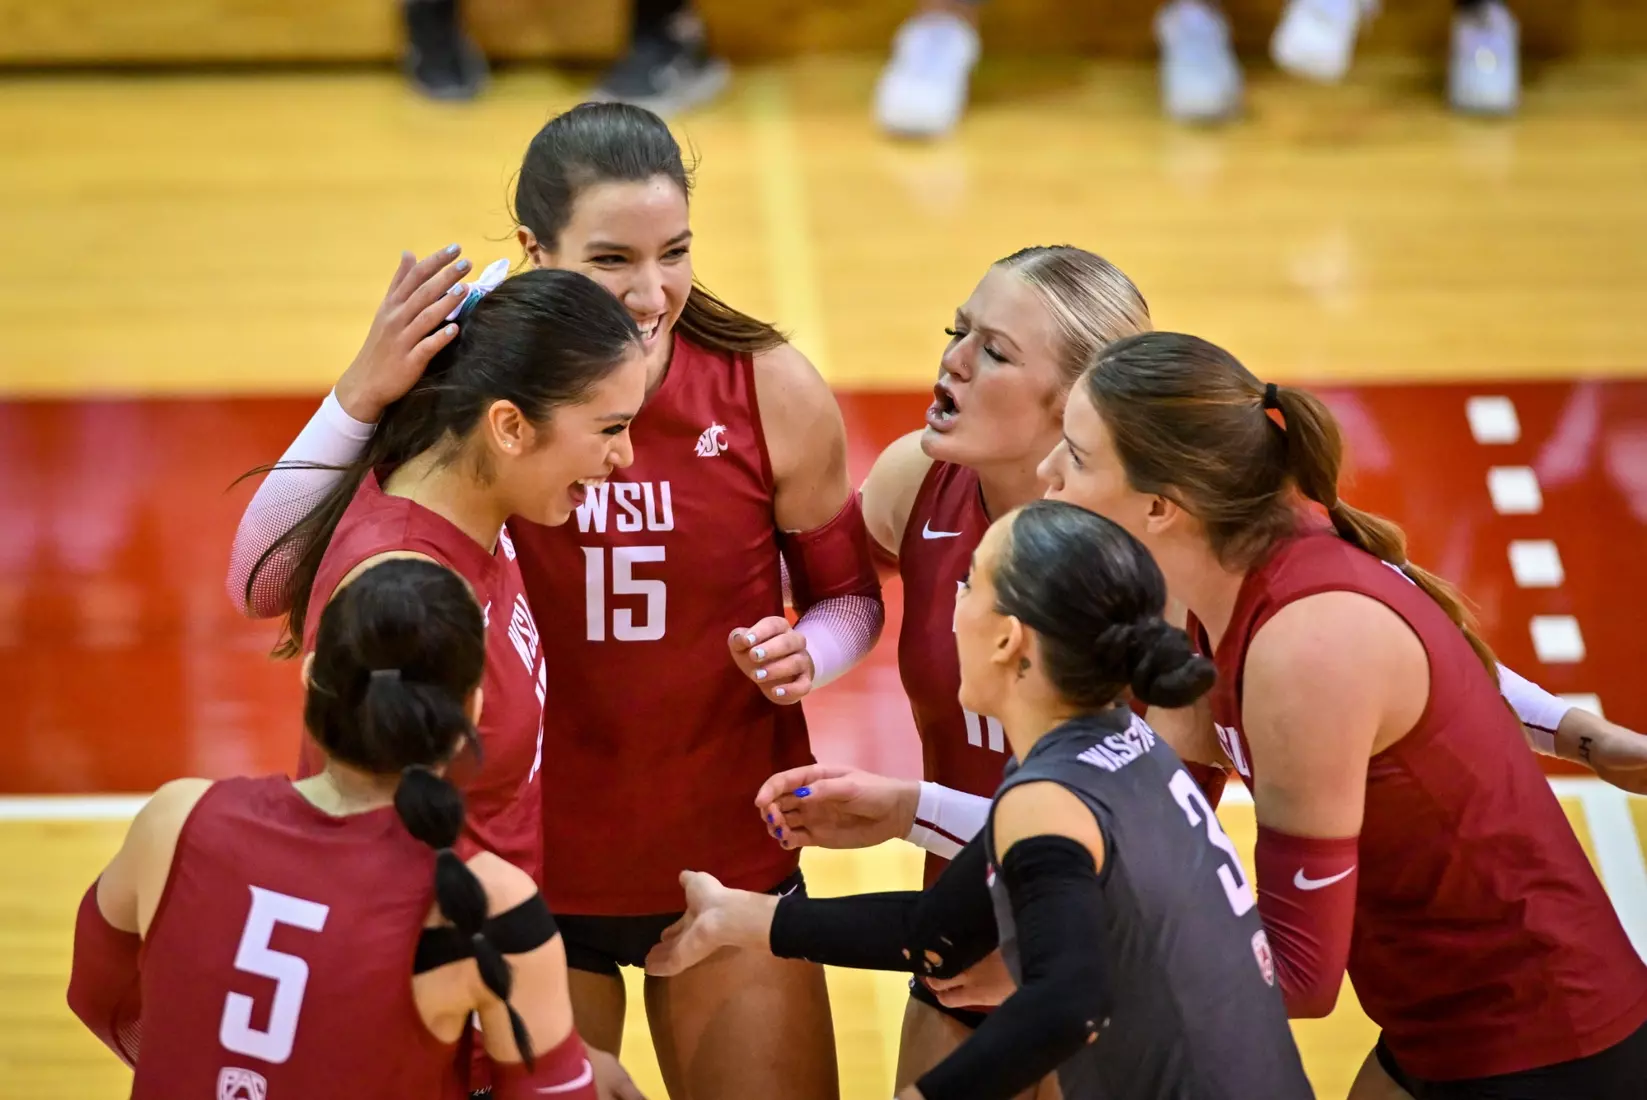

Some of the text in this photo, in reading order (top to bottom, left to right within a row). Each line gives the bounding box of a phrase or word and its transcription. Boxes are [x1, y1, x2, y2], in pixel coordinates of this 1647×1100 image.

[576, 481, 674, 533] WSU
[580, 545, 666, 641] 15
[1168, 769, 1257, 916] 3
[218, 884, 330, 1064] 5
